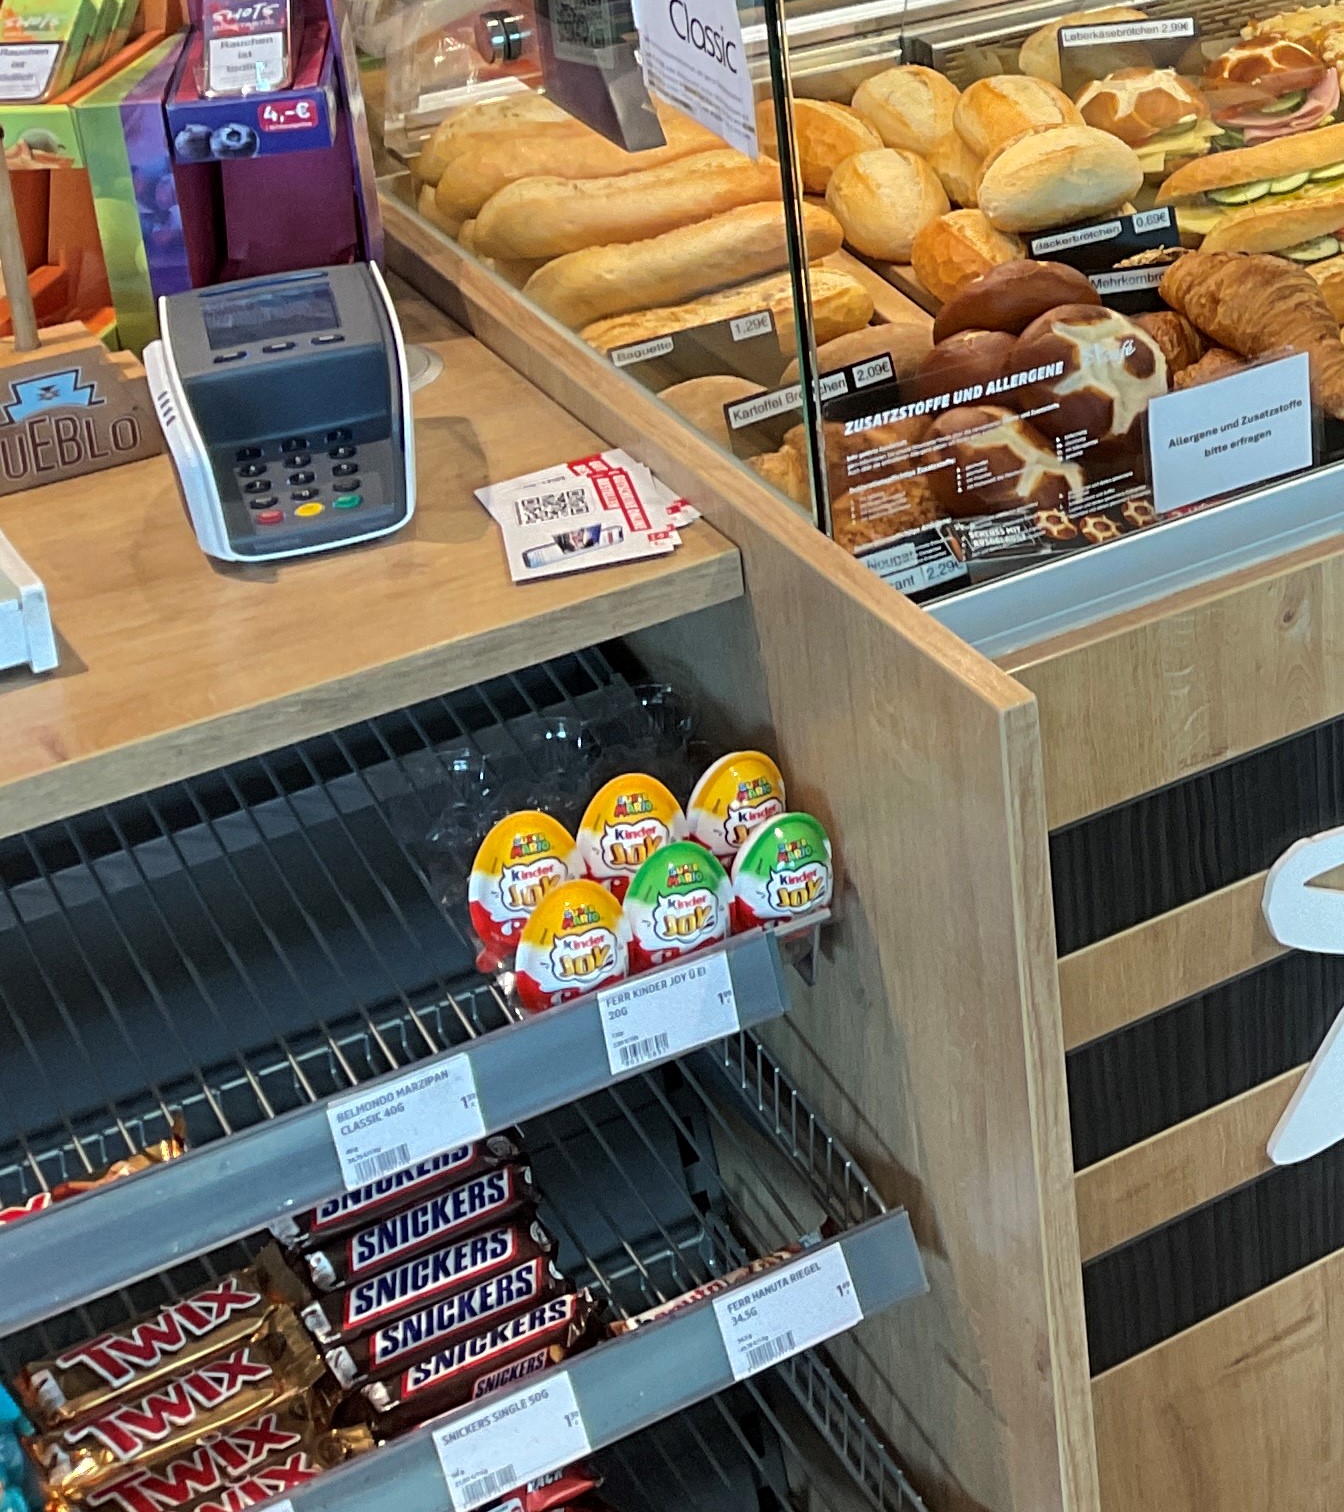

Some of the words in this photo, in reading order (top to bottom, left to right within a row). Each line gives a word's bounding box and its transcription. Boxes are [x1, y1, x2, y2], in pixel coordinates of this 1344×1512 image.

[617, 340, 673, 363] Baguette
[731, 398, 782, 424] Kartoffel
[855, 362, 892, 385] 2,09€
[844, 390, 952, 437] ZUSATZSTOFFE
[952, 382, 985, 407] UND
[985, 360, 1066, 397] ALLERGENE
[1168, 424, 1219, 450] Allergene
[1219, 415, 1241, 434] und
[1241, 397, 1305, 428] Zusatzstoffe
[1203, 440, 1229, 459] bitte
[1229, 427, 1273, 453] erfragen
[605, 989, 631, 1008] FERR
[631, 978, 668, 1001] KINDER
[669, 972, 689, 988] JOY
[608, 1005, 629, 1021] 20G
[336, 1090, 395, 1124] BELMONDO
[396, 1067, 449, 1102] MARZIPAN
[340, 1113, 384, 1138] CLASSIC
[384, 1102, 406, 1120] 40G
[355, 1173, 508, 1264] SNICKERS
[350, 1228, 511, 1316] SNICKERS
[726, 1295, 752, 1315] FERR
[751, 1276, 791, 1304] HANUTA
[790, 1261, 822, 1285] RIEGEL
[57, 1277, 261, 1387] TWIX
[376, 1262, 535, 1355] SNICKERS
[411, 1297, 570, 1386] SNICKERS
[475, 1350, 547, 1399] SNICKERS
[65, 1346, 273, 1461] TWIX
[441, 1417, 496, 1446] SNICKERS
[496, 1402, 528, 1426] SINGLE
[528, 1389, 550, 1408] 50G
[87, 1412, 301, 1512] TWIX
